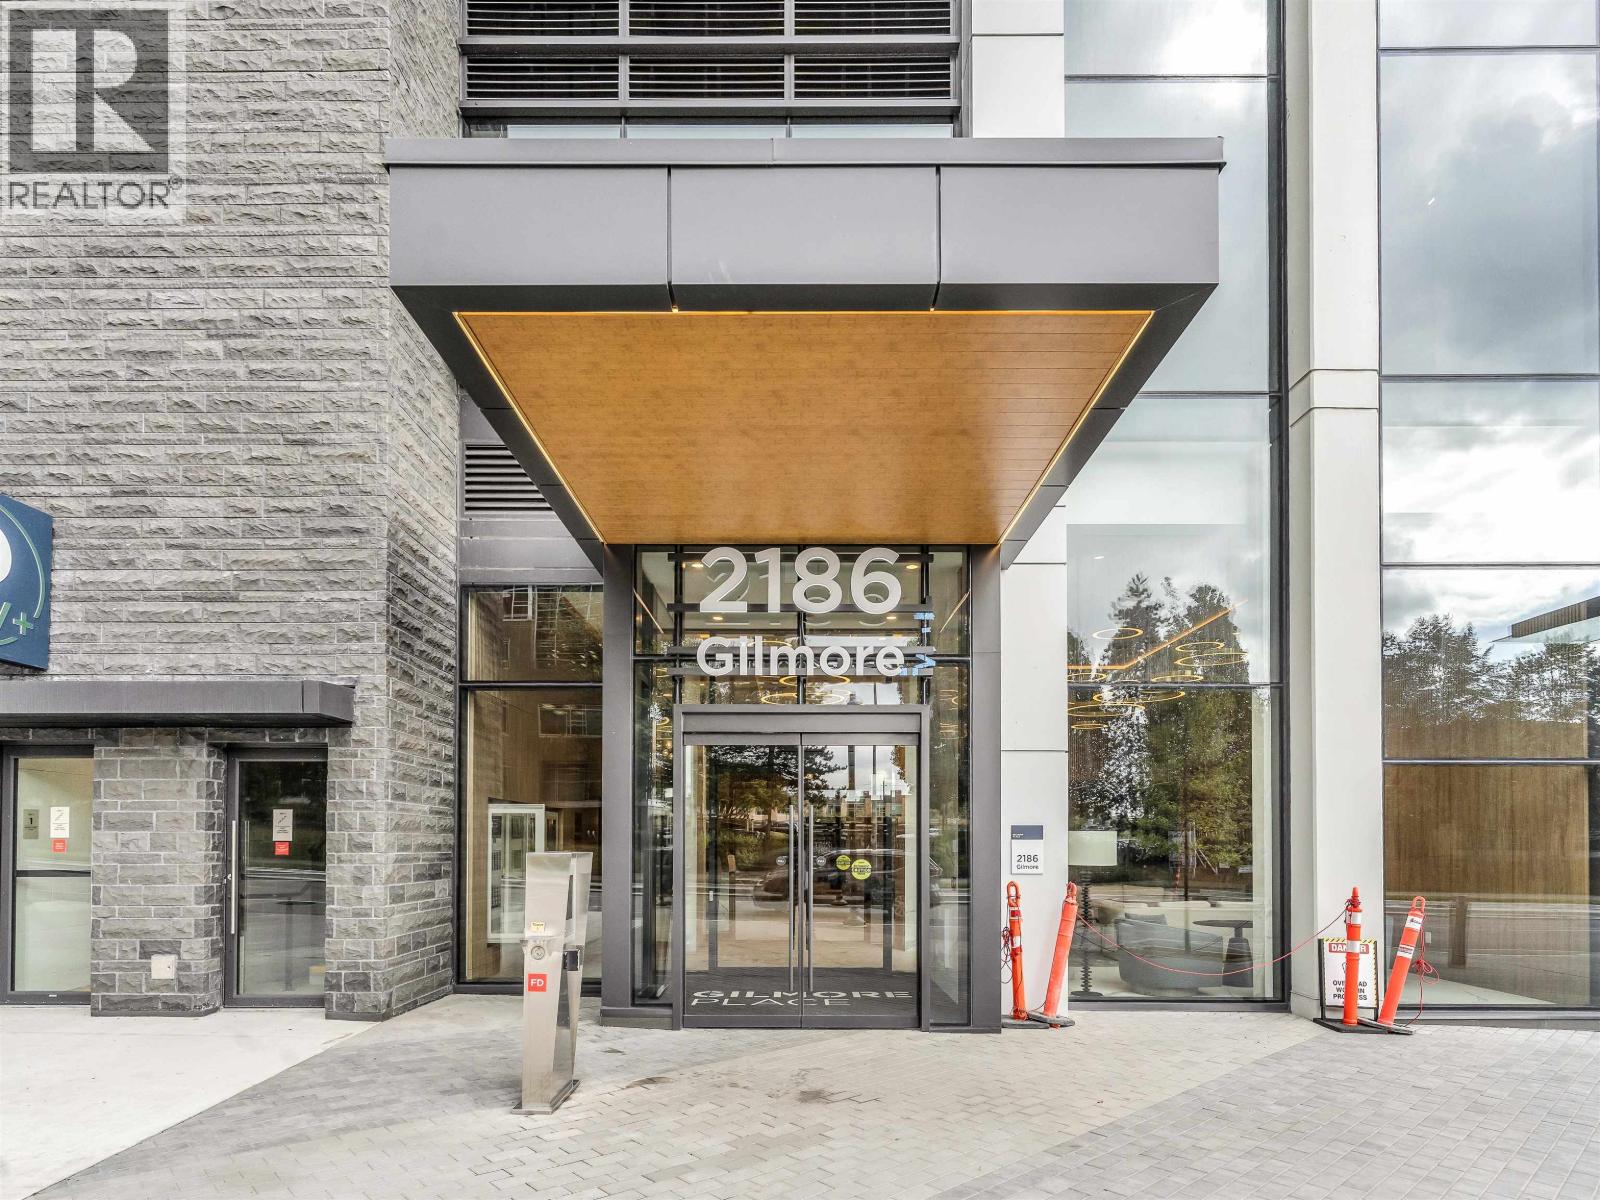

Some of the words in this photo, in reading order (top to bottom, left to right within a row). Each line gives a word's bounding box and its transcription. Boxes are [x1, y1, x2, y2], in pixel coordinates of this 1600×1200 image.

[700, 547, 902, 614] 2186
[696, 636, 905, 676] Gilmore
[1016, 854, 1039, 863] 2186
[530, 978, 544, 987] FD
